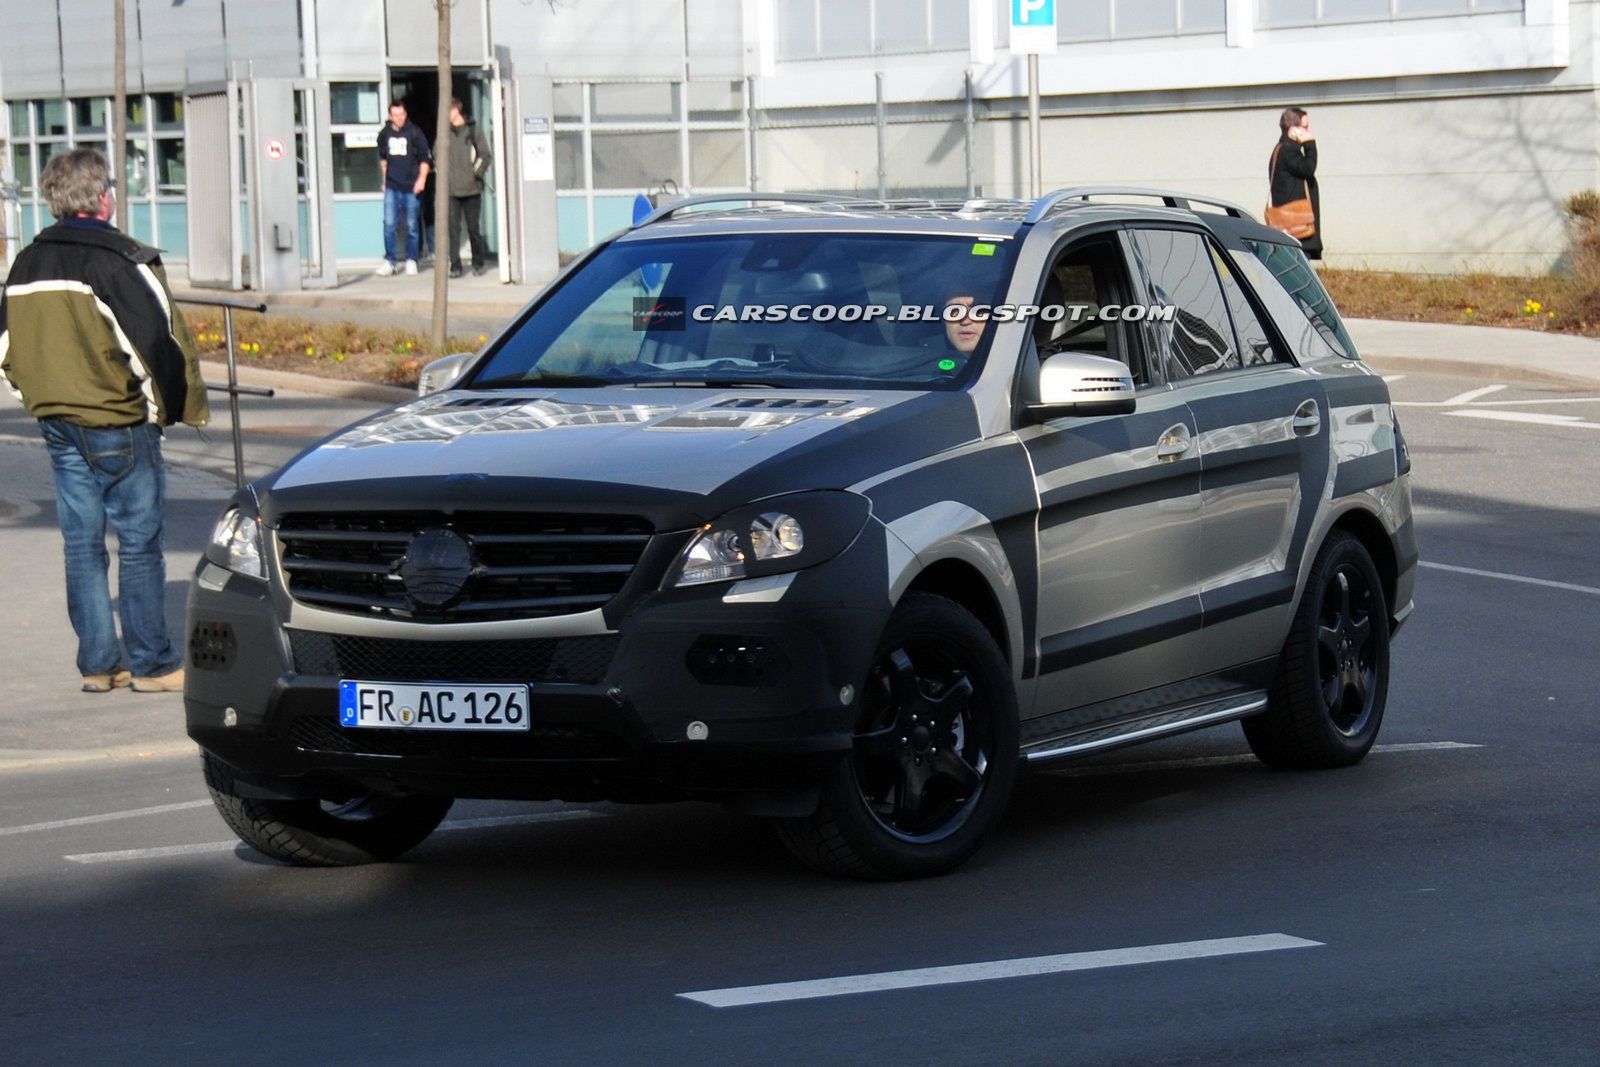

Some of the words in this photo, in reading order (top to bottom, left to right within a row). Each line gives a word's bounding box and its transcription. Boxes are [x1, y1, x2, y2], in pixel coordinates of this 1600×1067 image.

[1020, 0, 1047, 23] P
[346, 707, 354, 718] D
[360, 689, 396, 722] FR
[417, 691, 457, 724] AC
[464, 692, 523, 724] 126
